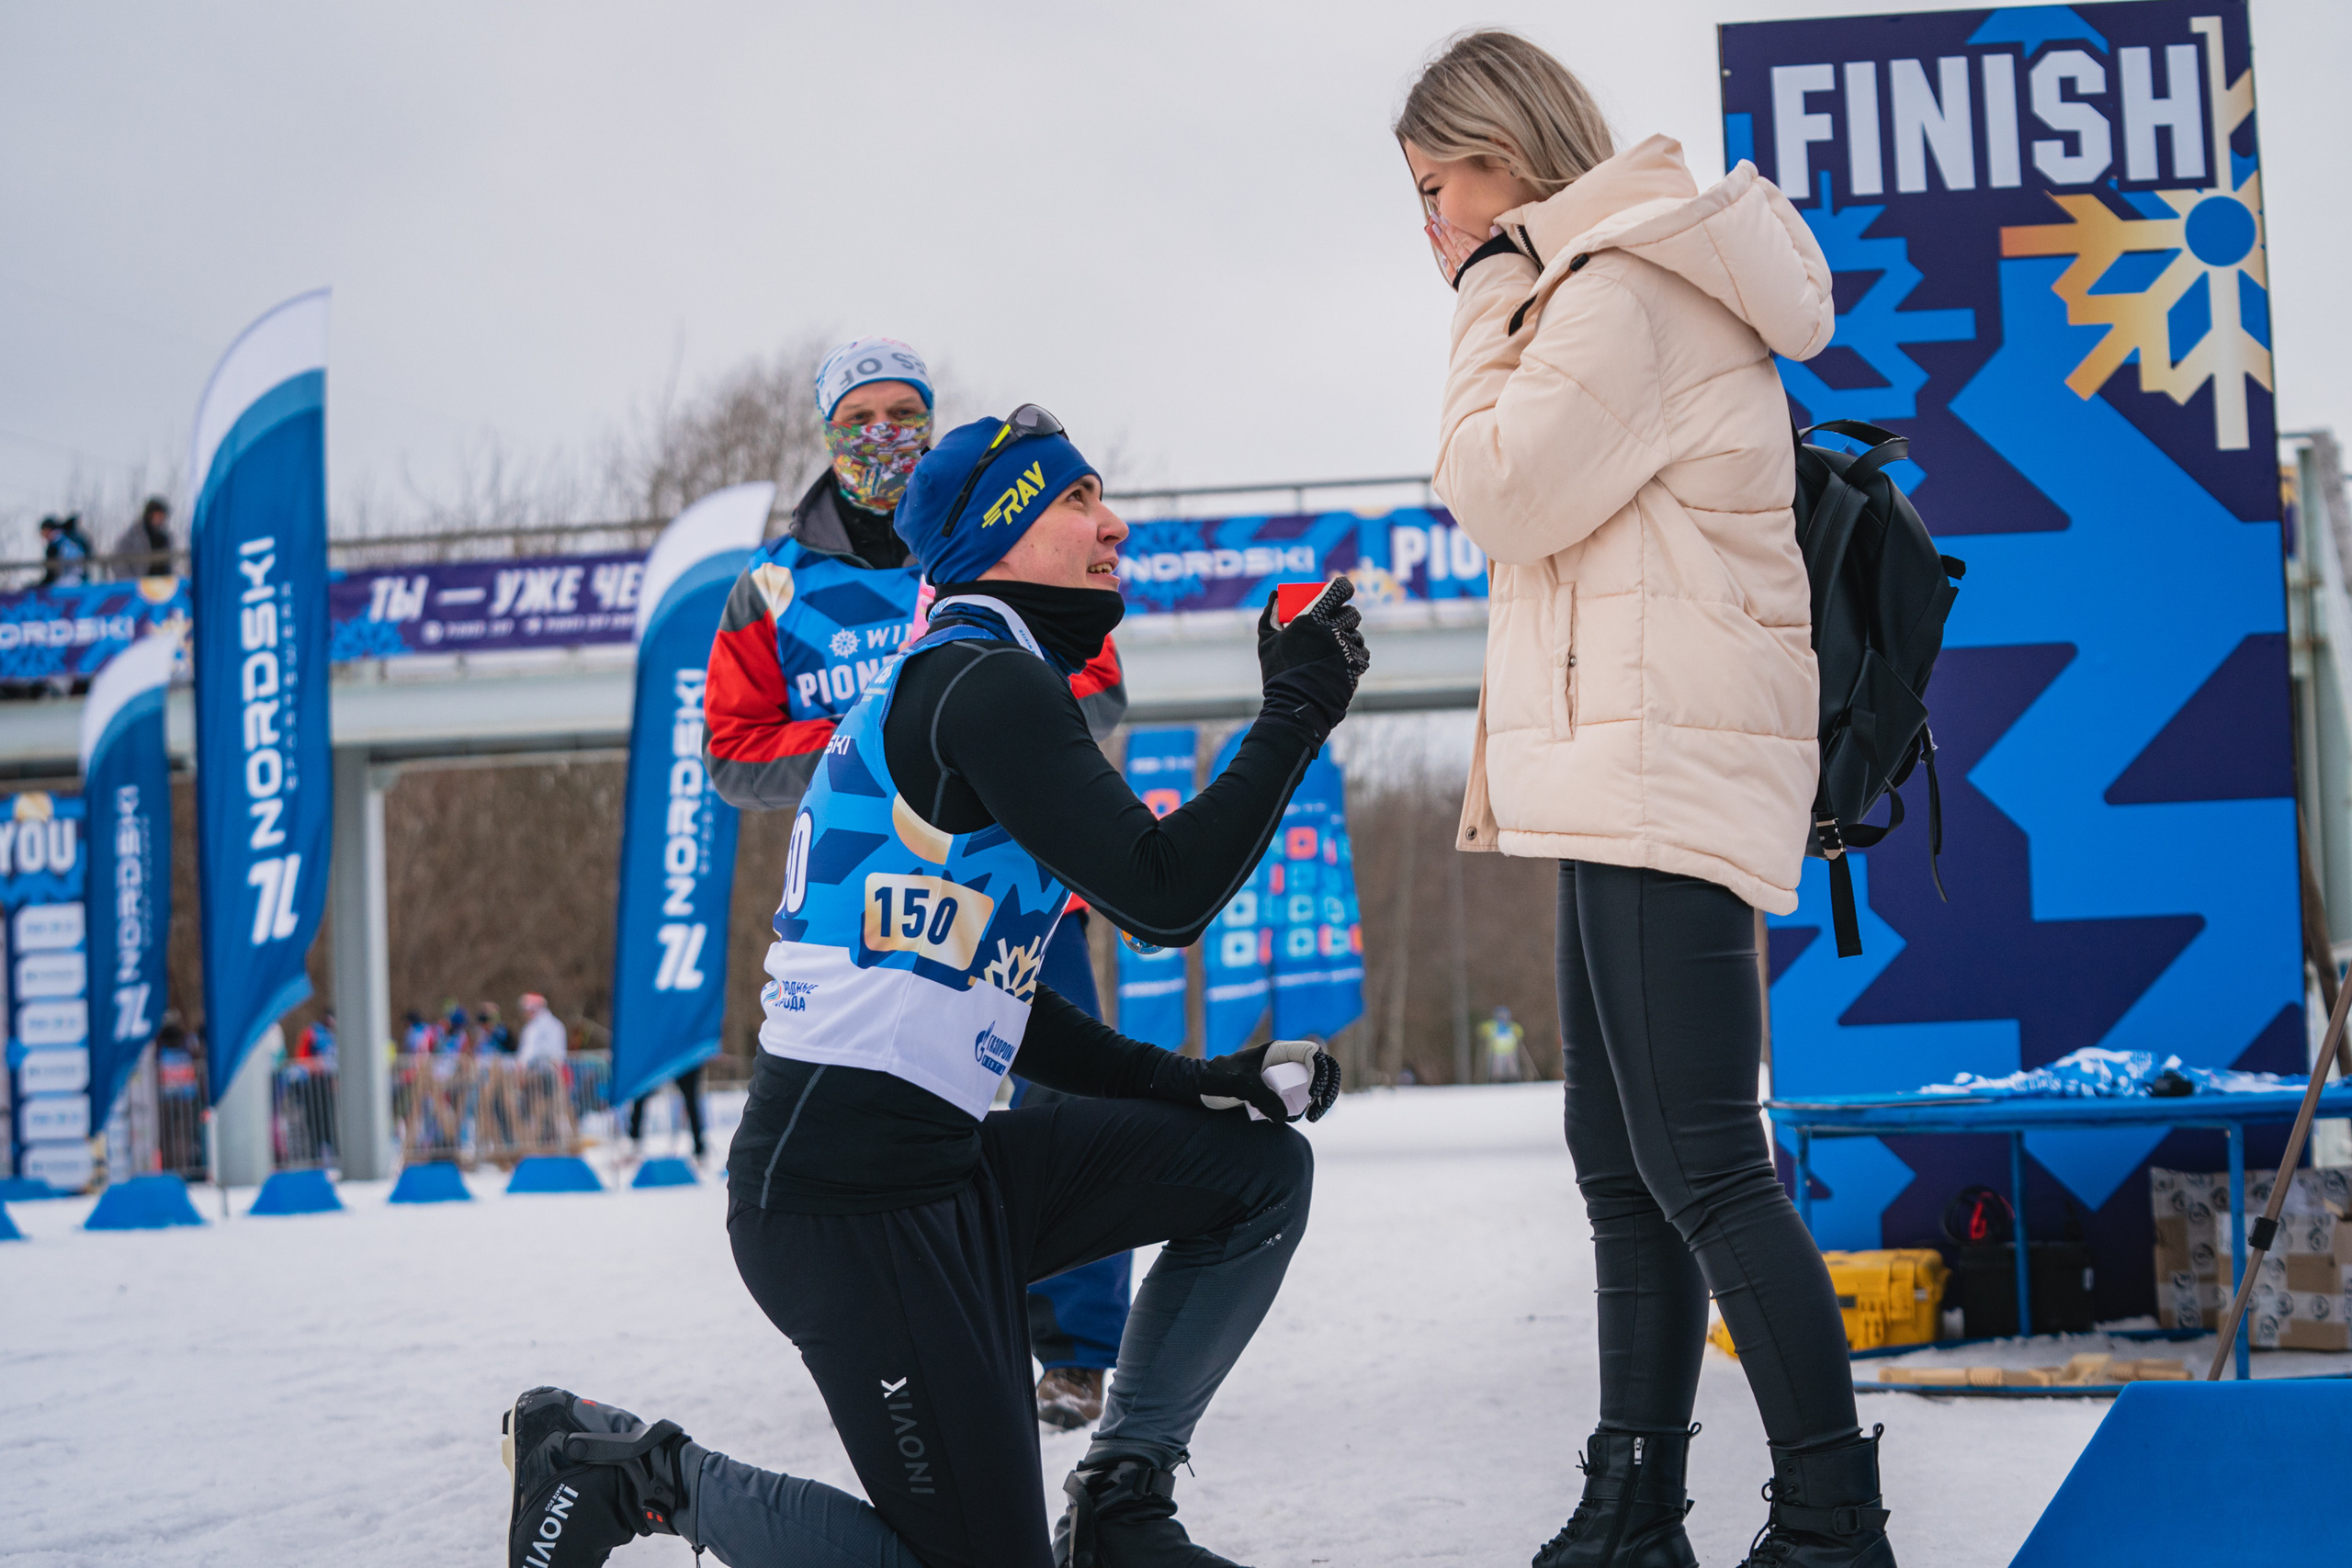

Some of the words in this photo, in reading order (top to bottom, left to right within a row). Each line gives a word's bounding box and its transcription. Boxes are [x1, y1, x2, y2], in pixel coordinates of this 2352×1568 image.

[1770, 44, 2207, 200] FINISH
[981, 460, 1046, 528] RAY
[368, 574, 429, 623] ТЫ
[489, 564, 585, 616] УЖЕ
[1117, 545, 1315, 582] NORDSKI
[1331, 627, 1354, 664] INOVIK
[238, 536, 285, 851] NORDSKI
[662, 669, 706, 917] NORDSKI
[115, 784, 141, 983] NORDSKI
[875, 886, 958, 945] 150
[987, 1034, 1015, 1062] ГАЗПРОМ
[881, 1377, 935, 1494] INOVIK
[522, 1485, 579, 1568] INOVI
